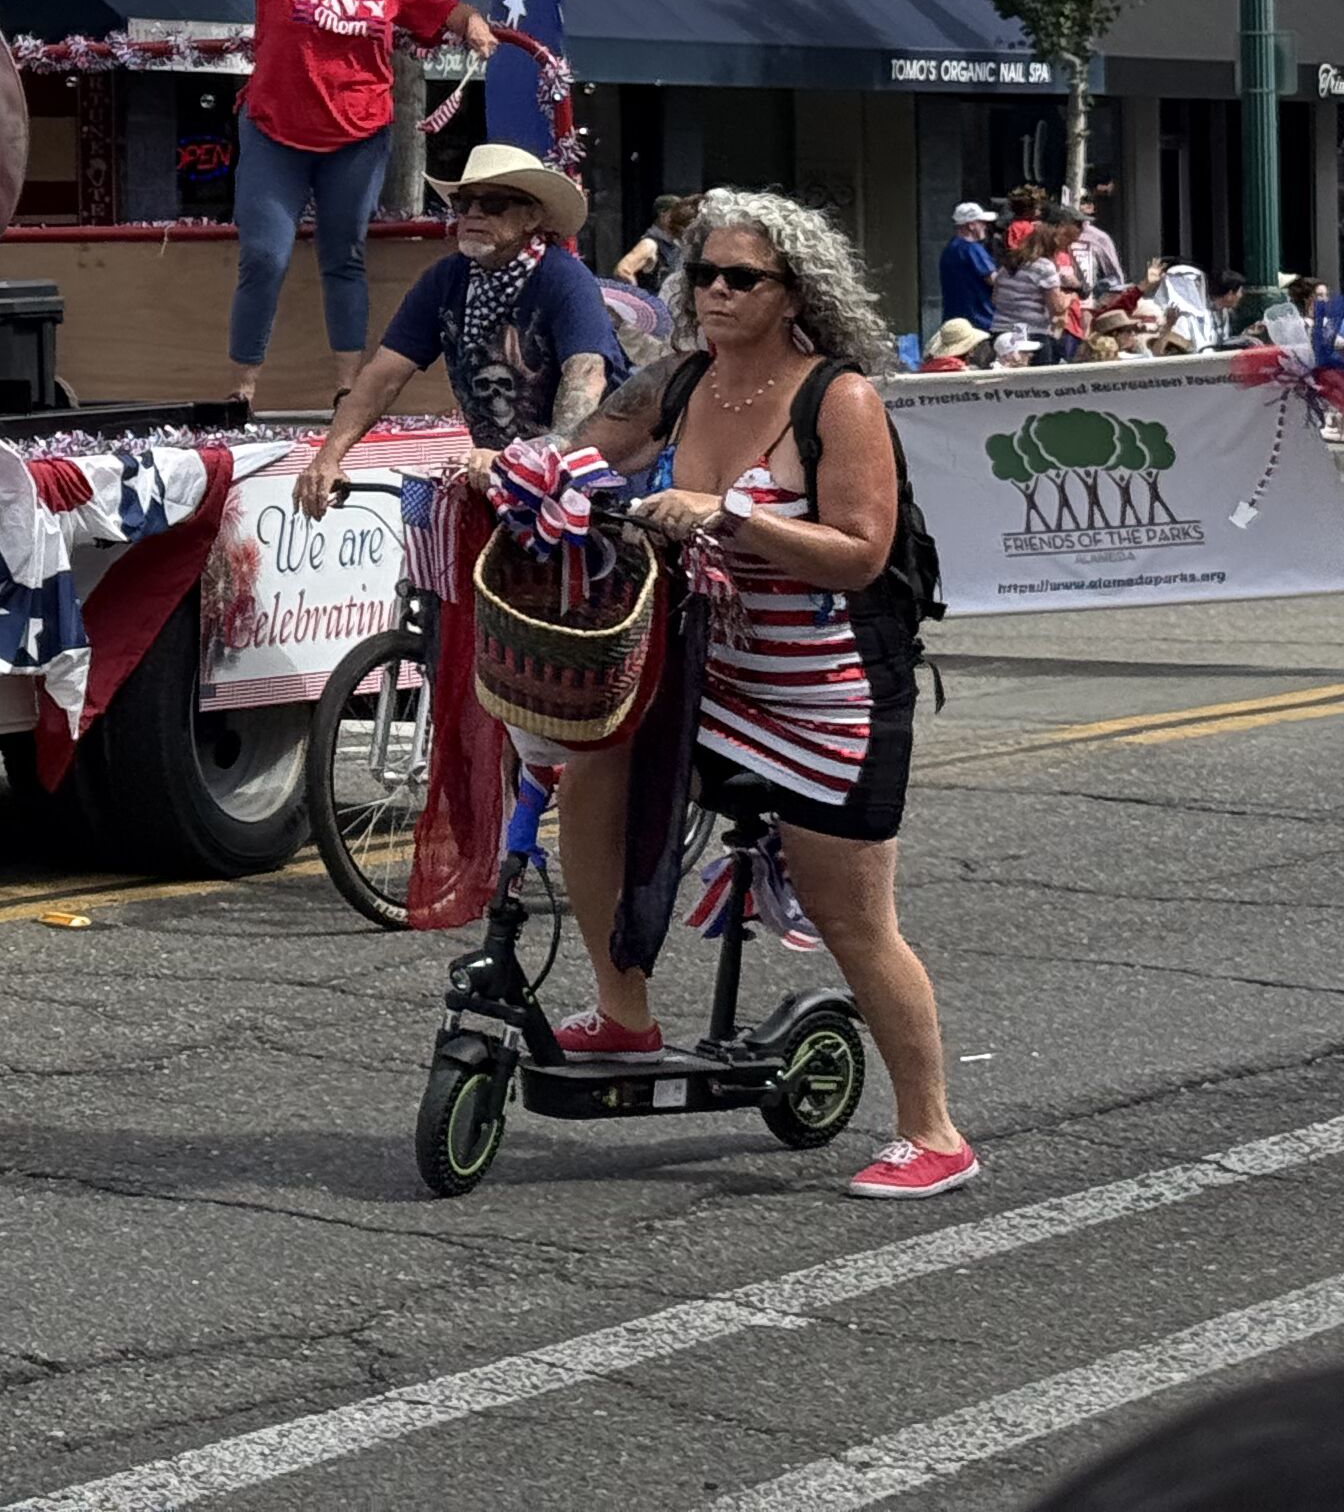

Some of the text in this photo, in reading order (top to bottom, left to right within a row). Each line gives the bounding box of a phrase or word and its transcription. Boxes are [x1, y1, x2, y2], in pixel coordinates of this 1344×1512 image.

[314, 6, 368, 37] Mom
[891, 59, 1051, 83] TOMO'S ORGANIC NAIL SPA
[1054, 383, 1087, 397] and
[257, 506, 384, 573] We are
[1003, 524, 1205, 553] FRIENDS OF THE PARKS
